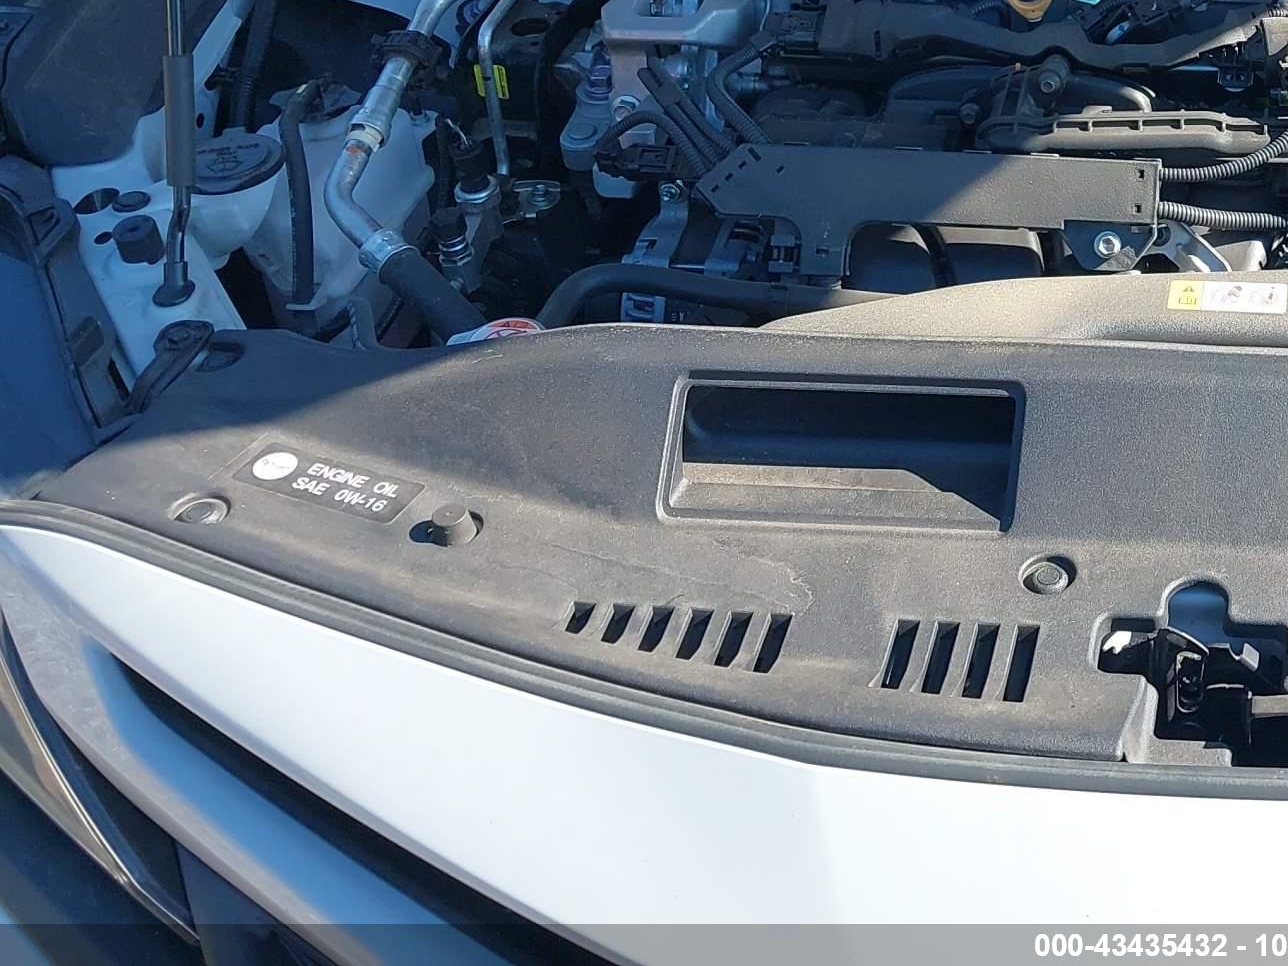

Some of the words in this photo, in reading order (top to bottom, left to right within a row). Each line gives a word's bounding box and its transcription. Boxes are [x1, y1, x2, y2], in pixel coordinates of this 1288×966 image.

[291, 477, 331, 496] SAE
[333, 489, 388, 512] 0W-16
[306, 462, 370, 489] ENGINE
[373, 482, 401, 498] OIL
